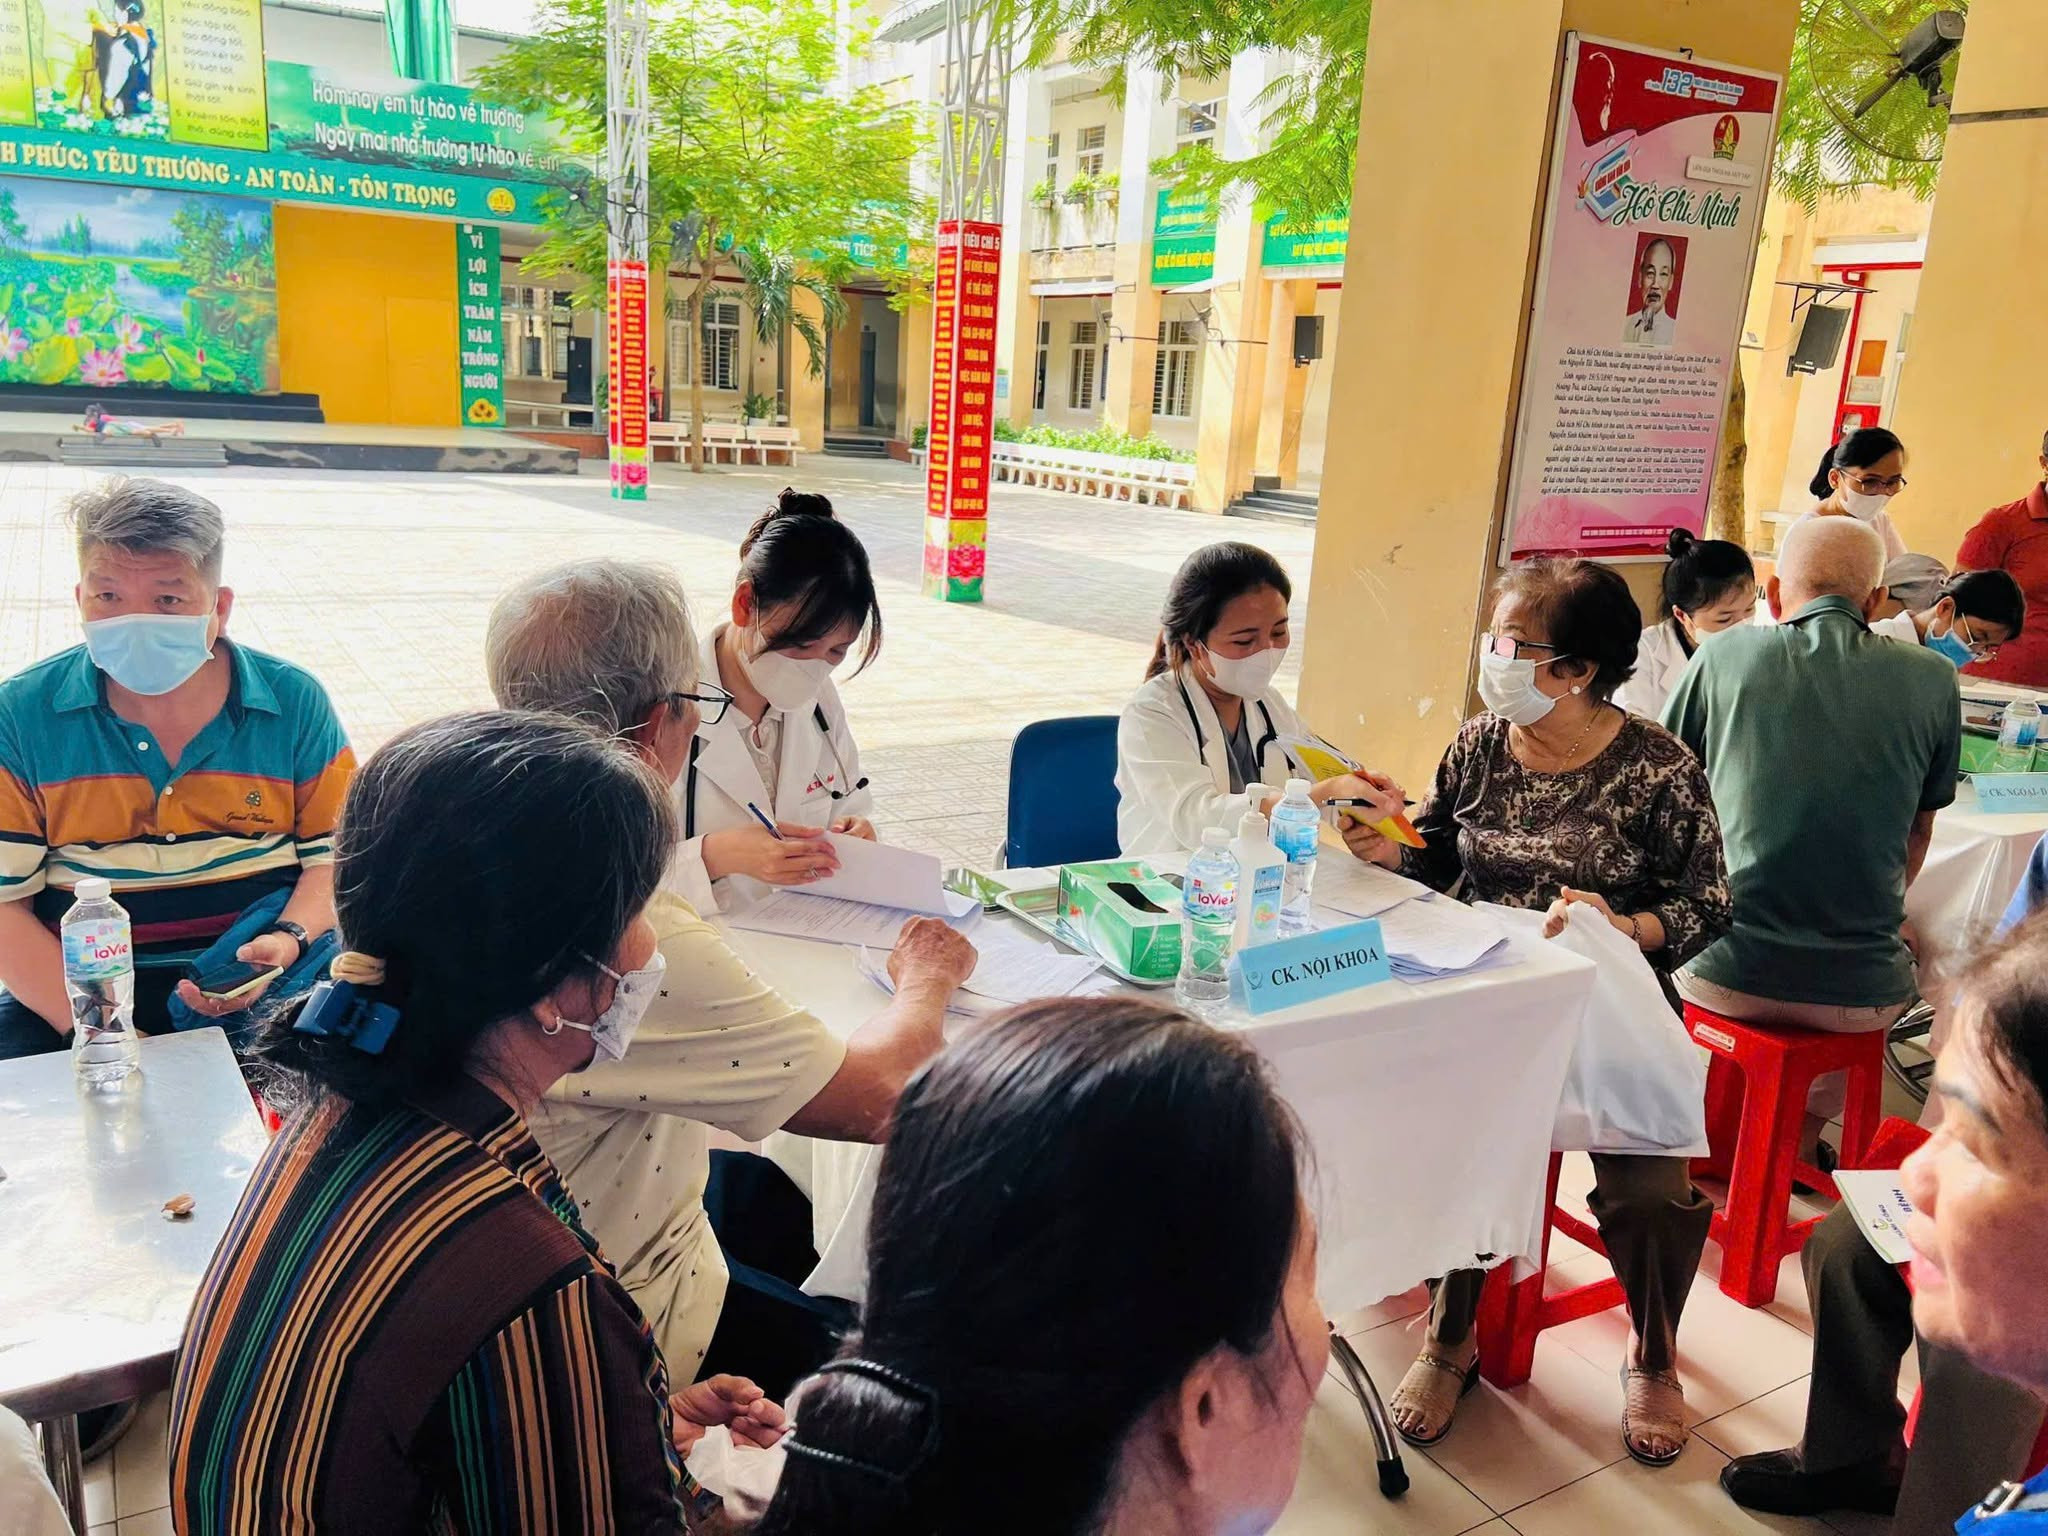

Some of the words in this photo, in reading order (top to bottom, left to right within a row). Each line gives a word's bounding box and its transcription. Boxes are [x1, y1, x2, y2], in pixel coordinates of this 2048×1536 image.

[312, 81, 347, 107] Hôm
[349, 92, 379, 114] nay
[383, 97, 407, 114] em
[428, 97, 456, 120] hào
[459, 101, 477, 123] về
[1662, 68, 1694, 95] 132
[314, 122, 355, 152] Ngày
[360, 130, 388, 150] mai
[518, 147, 535, 166] về
[22, 141, 89, 170] PHÚC:
[93, 147, 138, 175] YÊU
[142, 156, 230, 184] THƯƠNG
[245, 167, 275, 188] AN
[279, 167, 335, 195] TOÀN
[349, 174, 388, 201] TÔN
[392, 182, 457, 209] TRỌNG
[1613, 181, 1657, 226] Hồ
[1658, 187, 1696, 223] Chí
[1687, 190, 1742, 230] Minh
[964, 231, 980, 248] TIÊU
[981, 233, 994, 249] CHÍ
[995, 238, 1001, 250] 5
[468, 279, 488, 297] ÍCH
[1271, 966, 1300, 986] CK.
[1302, 957, 1332, 979] NỘI
[1335, 946, 1380, 972] KHOA
